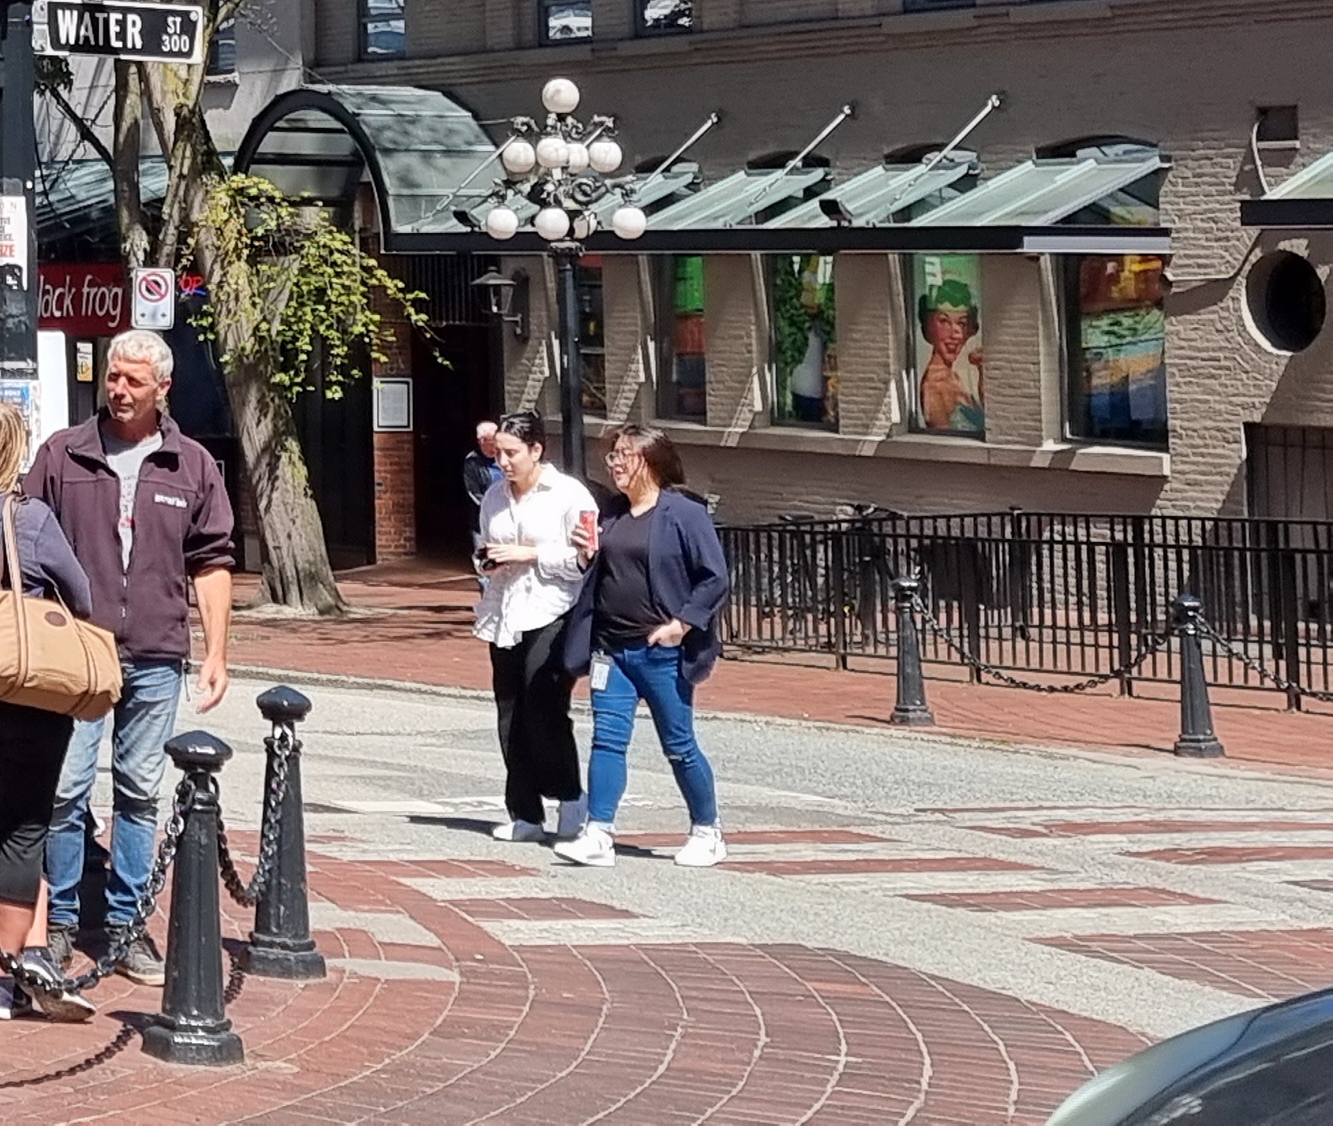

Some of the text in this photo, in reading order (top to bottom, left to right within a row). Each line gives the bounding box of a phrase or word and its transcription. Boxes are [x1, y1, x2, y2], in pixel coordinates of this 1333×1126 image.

[56, 8, 182, 50] WATER ST
[161, 34, 190, 53] 300
[37, 275, 124, 328] lack frog
